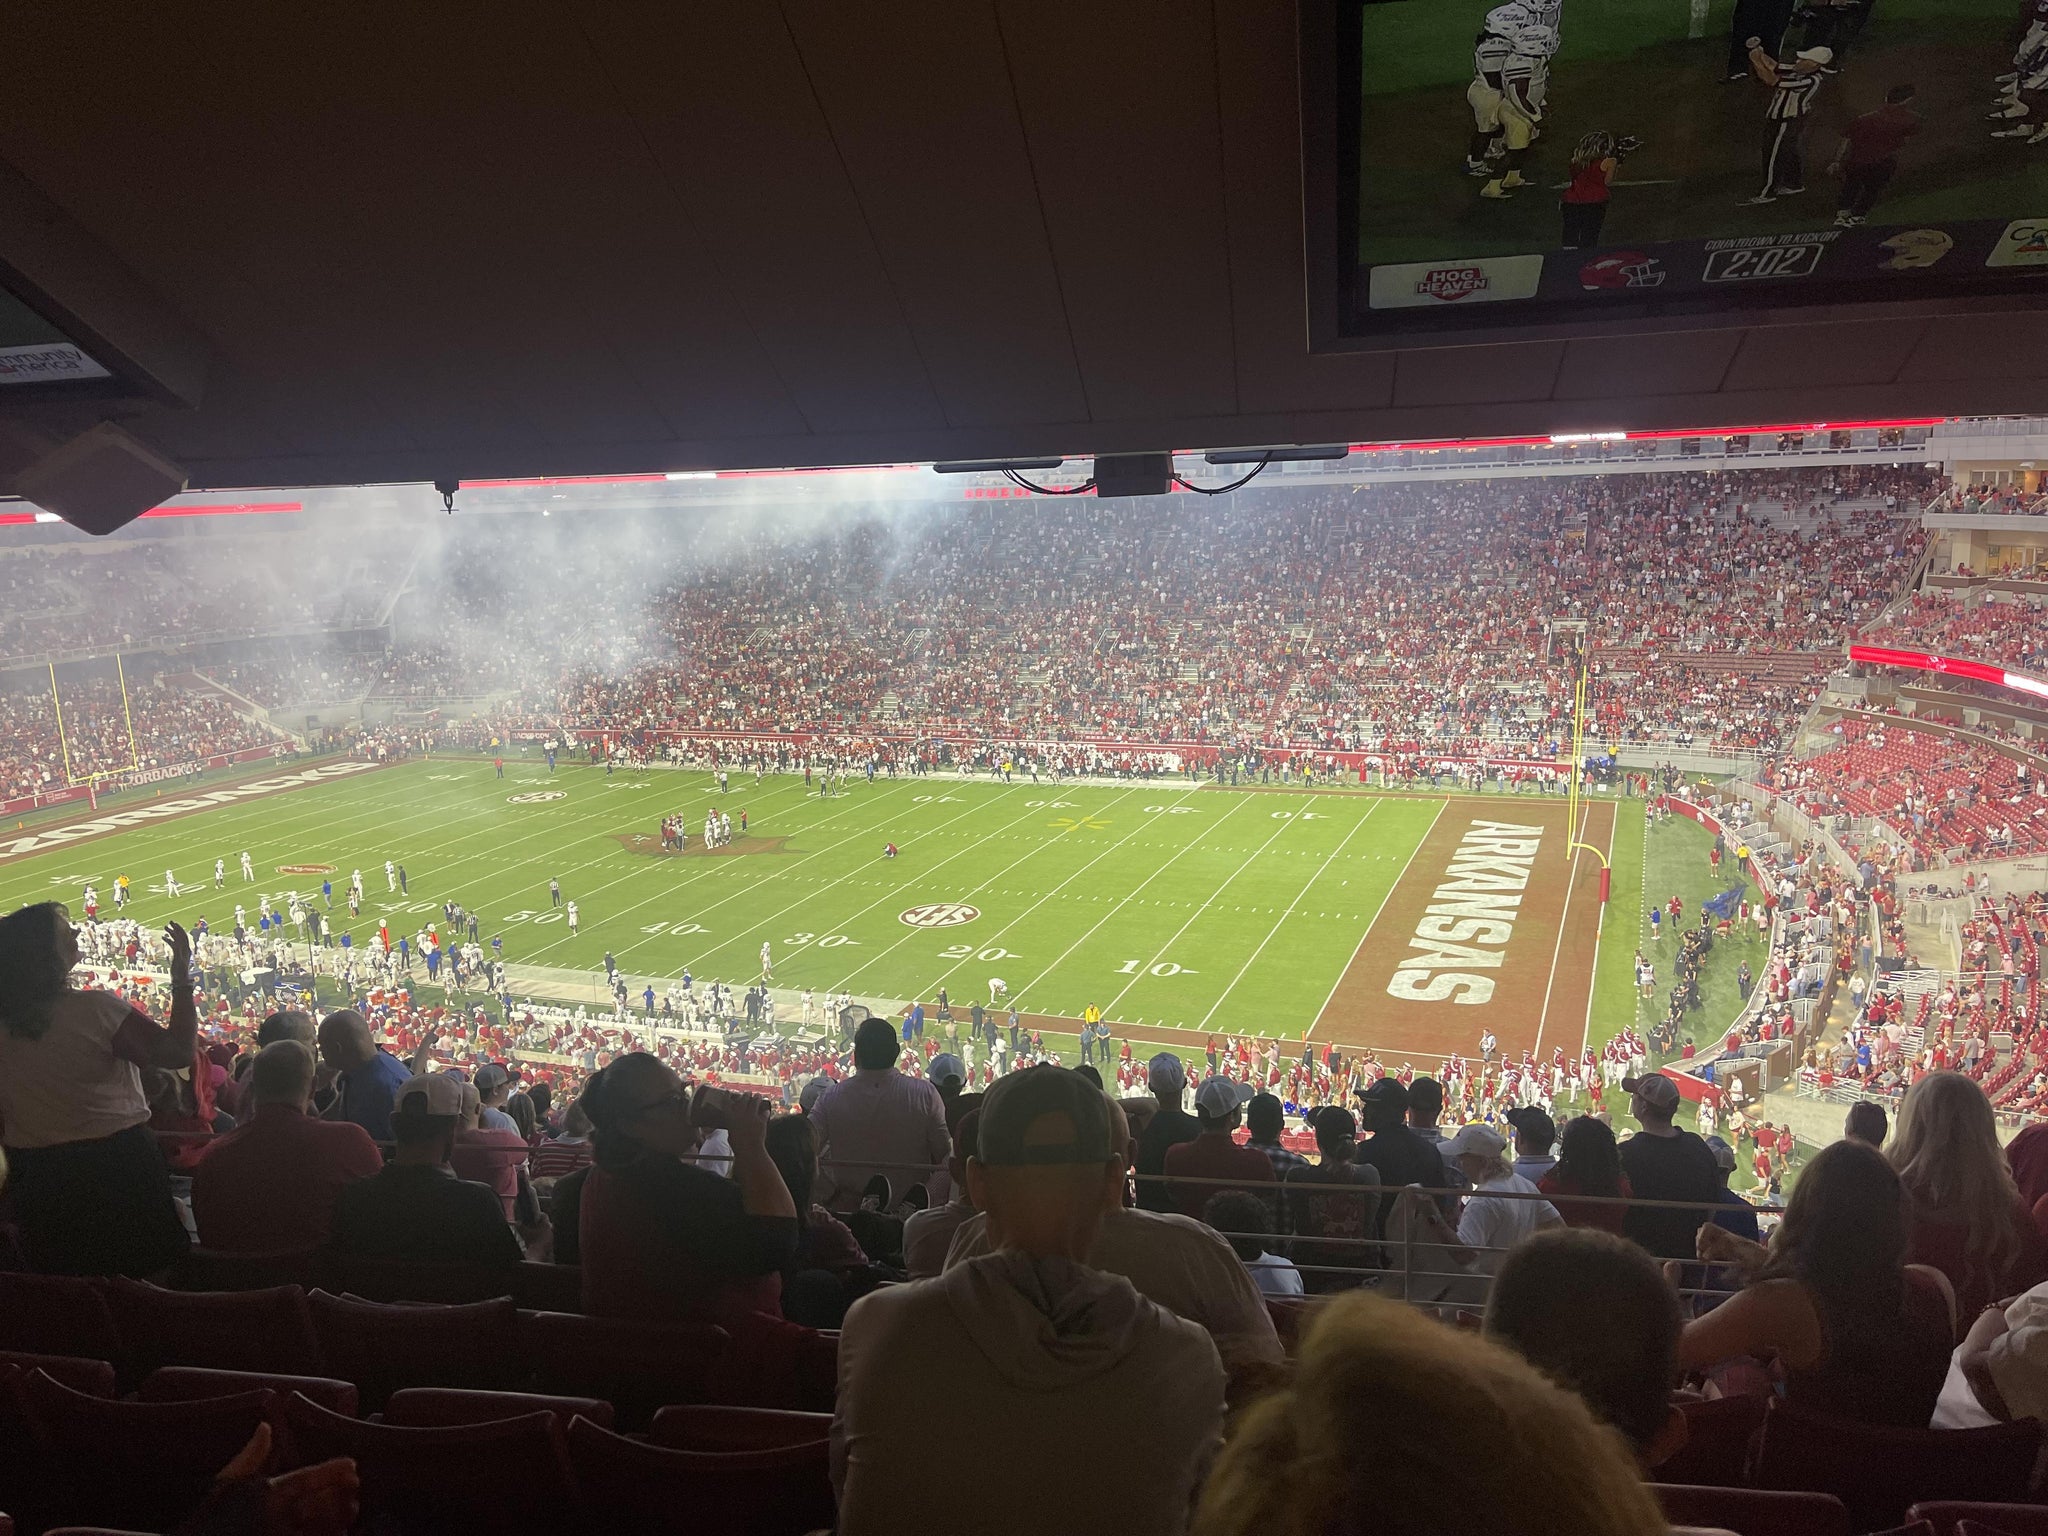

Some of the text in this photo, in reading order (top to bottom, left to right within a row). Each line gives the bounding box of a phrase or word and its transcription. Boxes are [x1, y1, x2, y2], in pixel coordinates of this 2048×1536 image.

[1704, 231, 1843, 250] COUNTDOWN TO KICKOFF
[1719, 247, 1806, 279] 2:02
[1432, 269, 1475, 282] HOG
[1418, 279, 1486, 293] HEAVEN
[0, 762, 380, 858] ZORBACKS
[502, 910, 565, 924] 50
[1386, 819, 1545, 1005] ARKANSAS
[639, 921, 702, 936] 40
[783, 932, 849, 948] 30
[936, 944, 1008, 961] 20
[1113, 959, 1182, 977] 10
